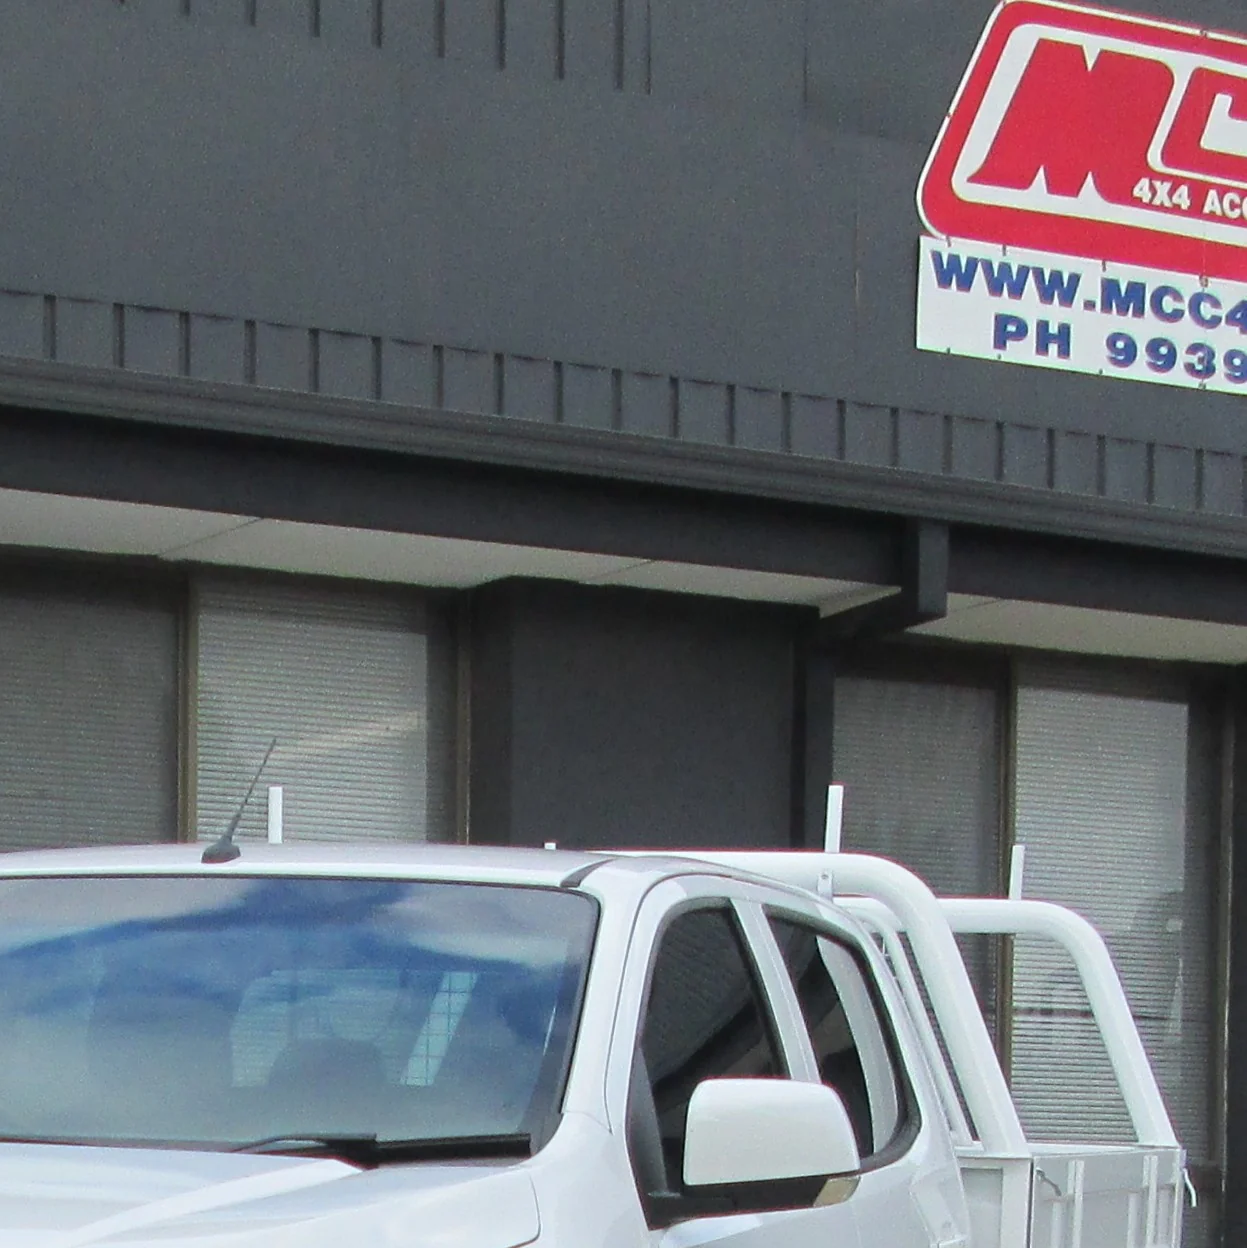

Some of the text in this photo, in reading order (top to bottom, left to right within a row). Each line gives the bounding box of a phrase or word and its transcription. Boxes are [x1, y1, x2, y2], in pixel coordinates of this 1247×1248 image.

[1133, 177, 1247, 220] 4X4 AC
[993, 313, 1247, 384] PH 9939
